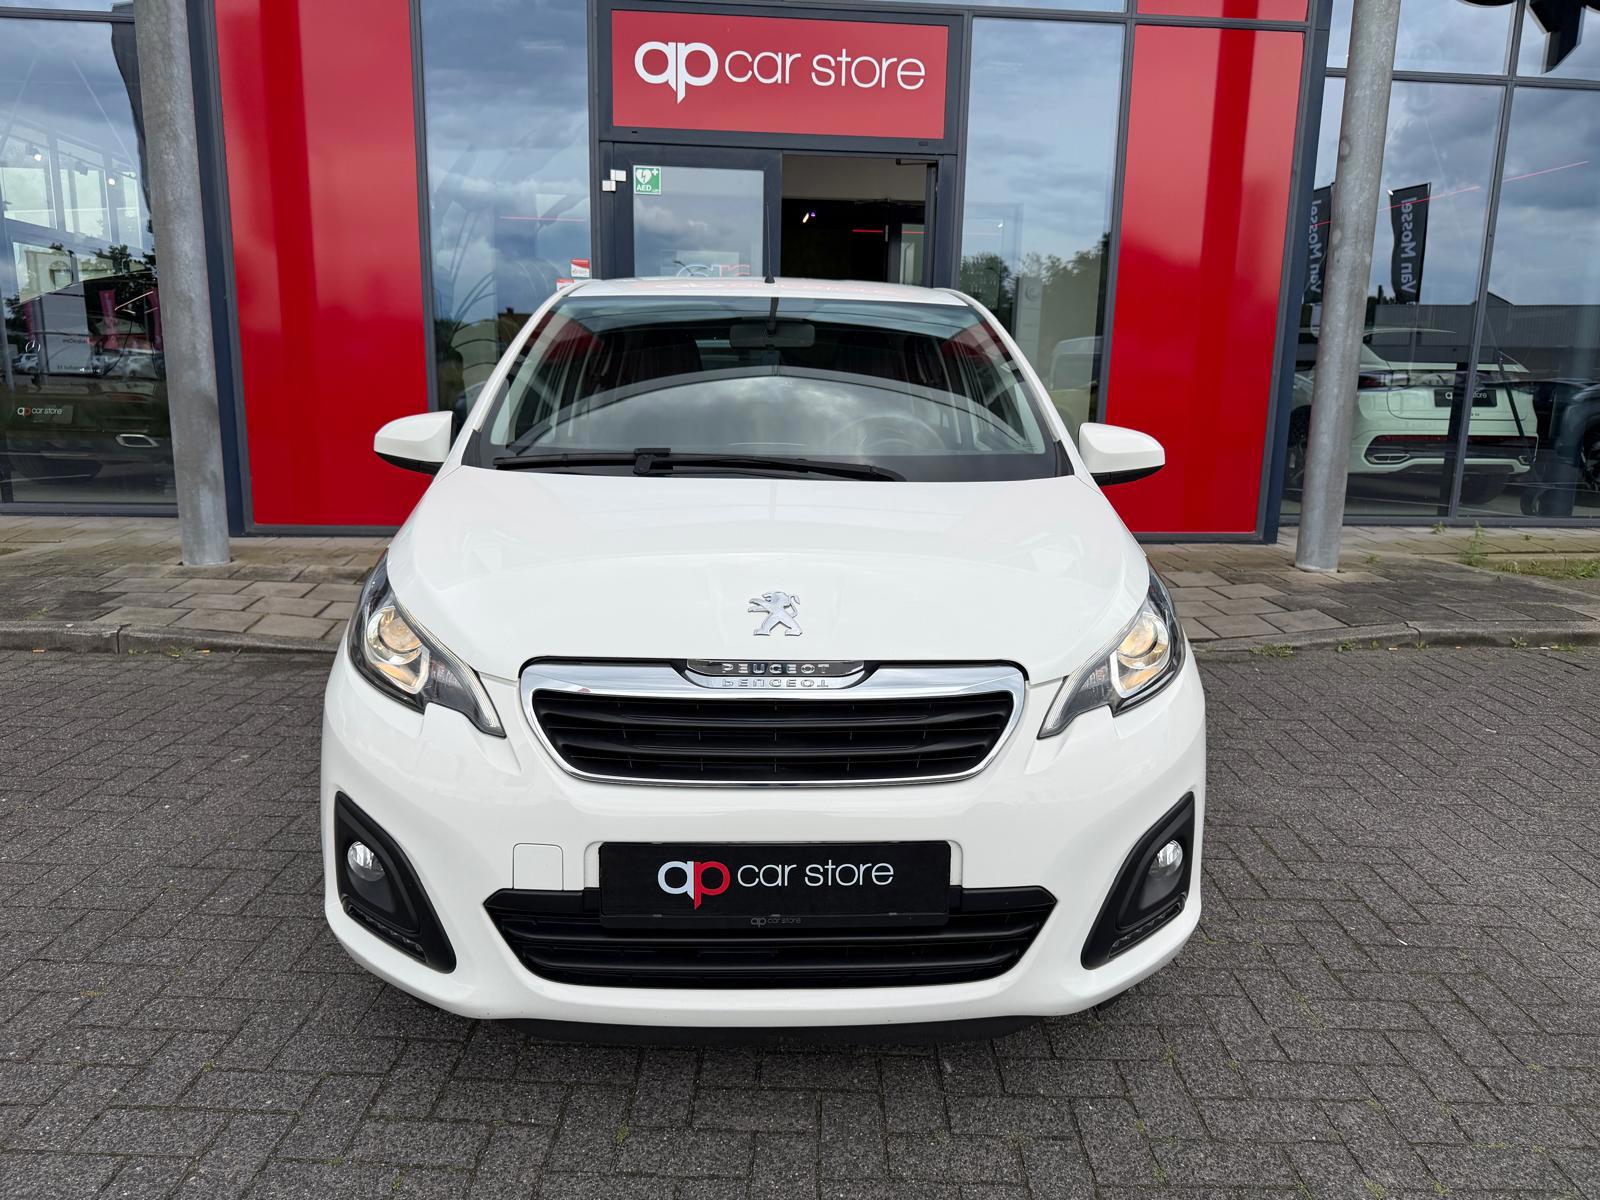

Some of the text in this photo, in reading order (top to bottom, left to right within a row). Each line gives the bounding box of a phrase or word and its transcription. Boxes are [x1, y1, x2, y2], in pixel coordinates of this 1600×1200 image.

[634, 41, 926, 104] ap car store
[636, 184, 652, 192] AED
[721, 663, 830, 675] PEUGEOT
[657, 859, 894, 910] ap car store
